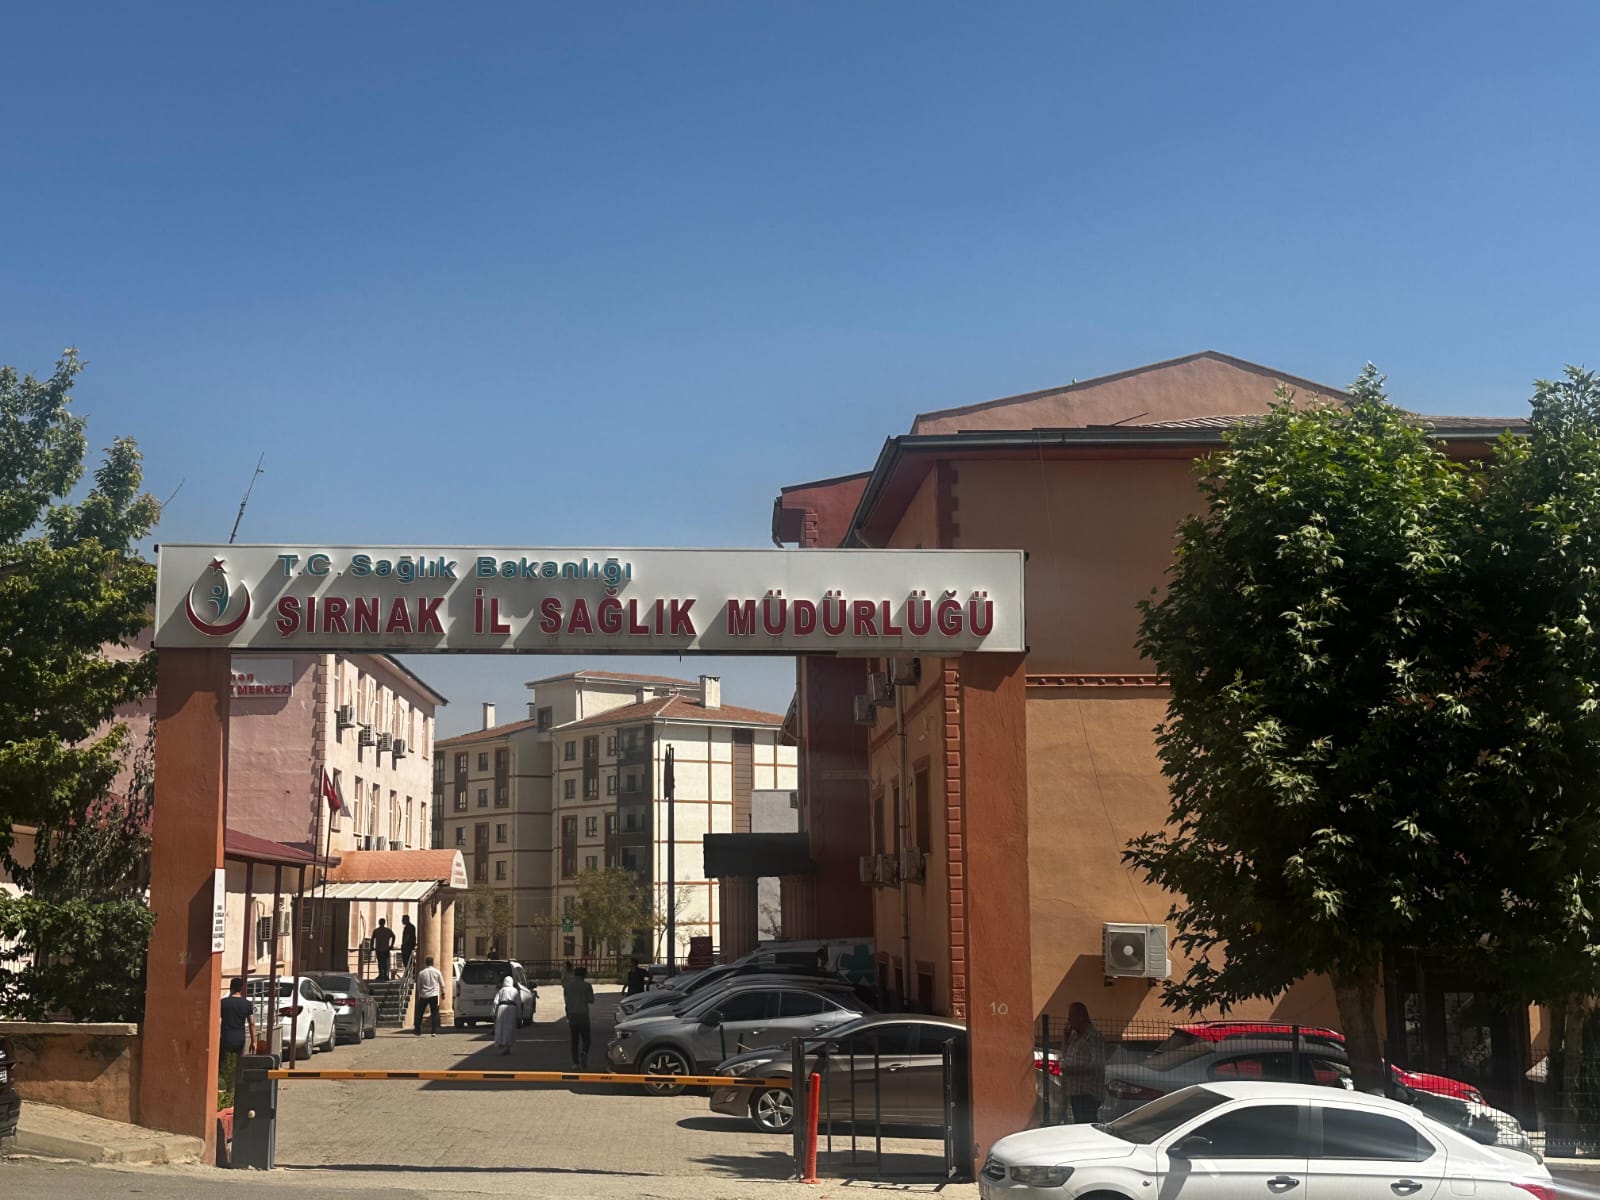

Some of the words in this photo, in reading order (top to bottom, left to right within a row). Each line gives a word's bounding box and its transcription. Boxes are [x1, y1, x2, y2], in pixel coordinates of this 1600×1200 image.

[277, 553, 342, 577] T.C.
[351, 554, 456, 584] Sağlık
[476, 556, 632, 587] Bakanlığı
[276, 595, 446, 639] ŞIRNAK
[474, 587, 511, 635] İL
[539, 587, 697, 636] SAĞLIK
[727, 589, 994, 637] MÜDÜRLÜĞÜ
[989, 1000, 1009, 1016] 10
